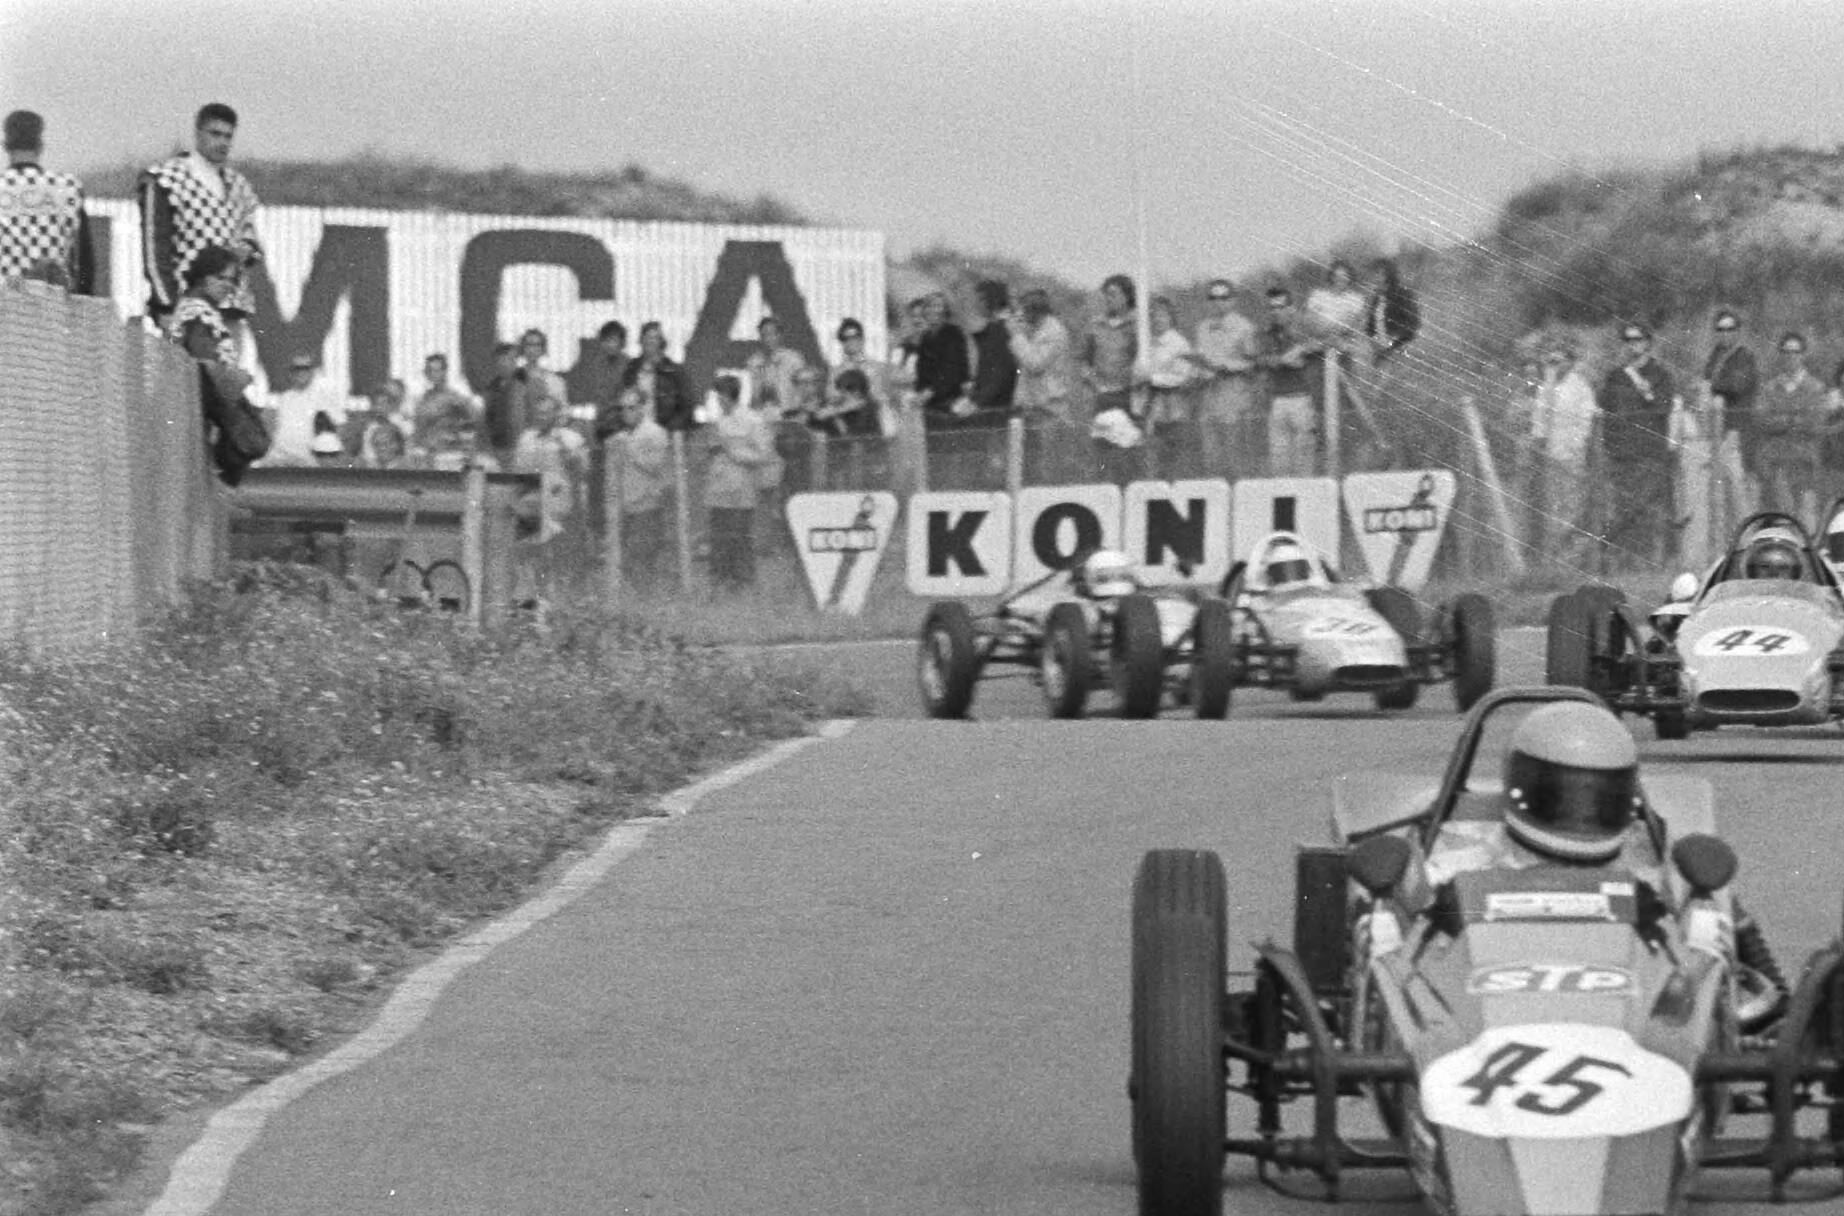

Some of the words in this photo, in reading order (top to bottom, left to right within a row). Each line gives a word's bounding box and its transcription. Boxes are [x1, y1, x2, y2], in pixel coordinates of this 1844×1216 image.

[1366, 509, 1435, 530] KONI
[1714, 629, 1791, 652] 44
[1481, 965, 1627, 990] STP
[1458, 1042, 1633, 1116] 45
